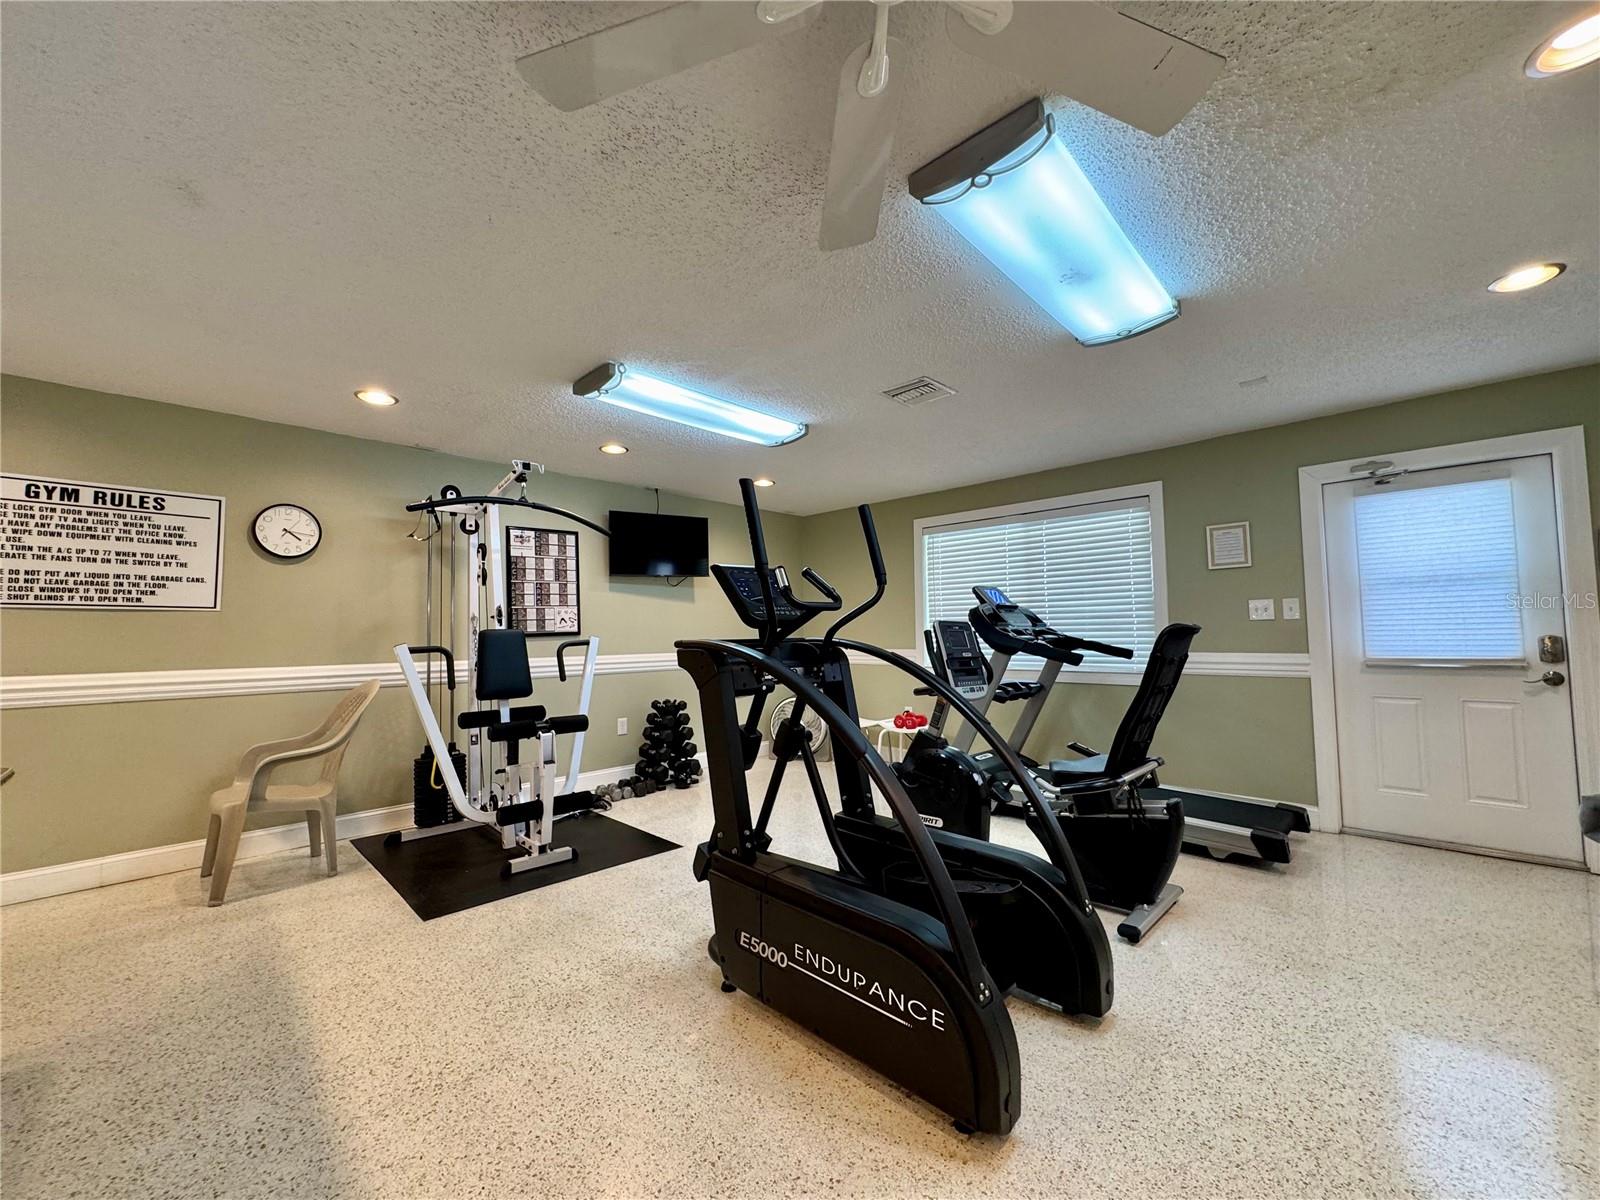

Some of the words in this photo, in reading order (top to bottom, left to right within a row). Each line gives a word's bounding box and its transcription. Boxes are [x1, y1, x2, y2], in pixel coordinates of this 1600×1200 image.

[25, 483, 80, 503] GYM
[94, 491, 165, 511] RULES
[55, 523, 98, 532] PROBLEMS
[66, 532, 111, 541] EQUIPMENT
[137, 537, 172, 545] CLEANING
[740, 930, 788, 968] E5000
[794, 942, 945, 1031] ENDURANCE
